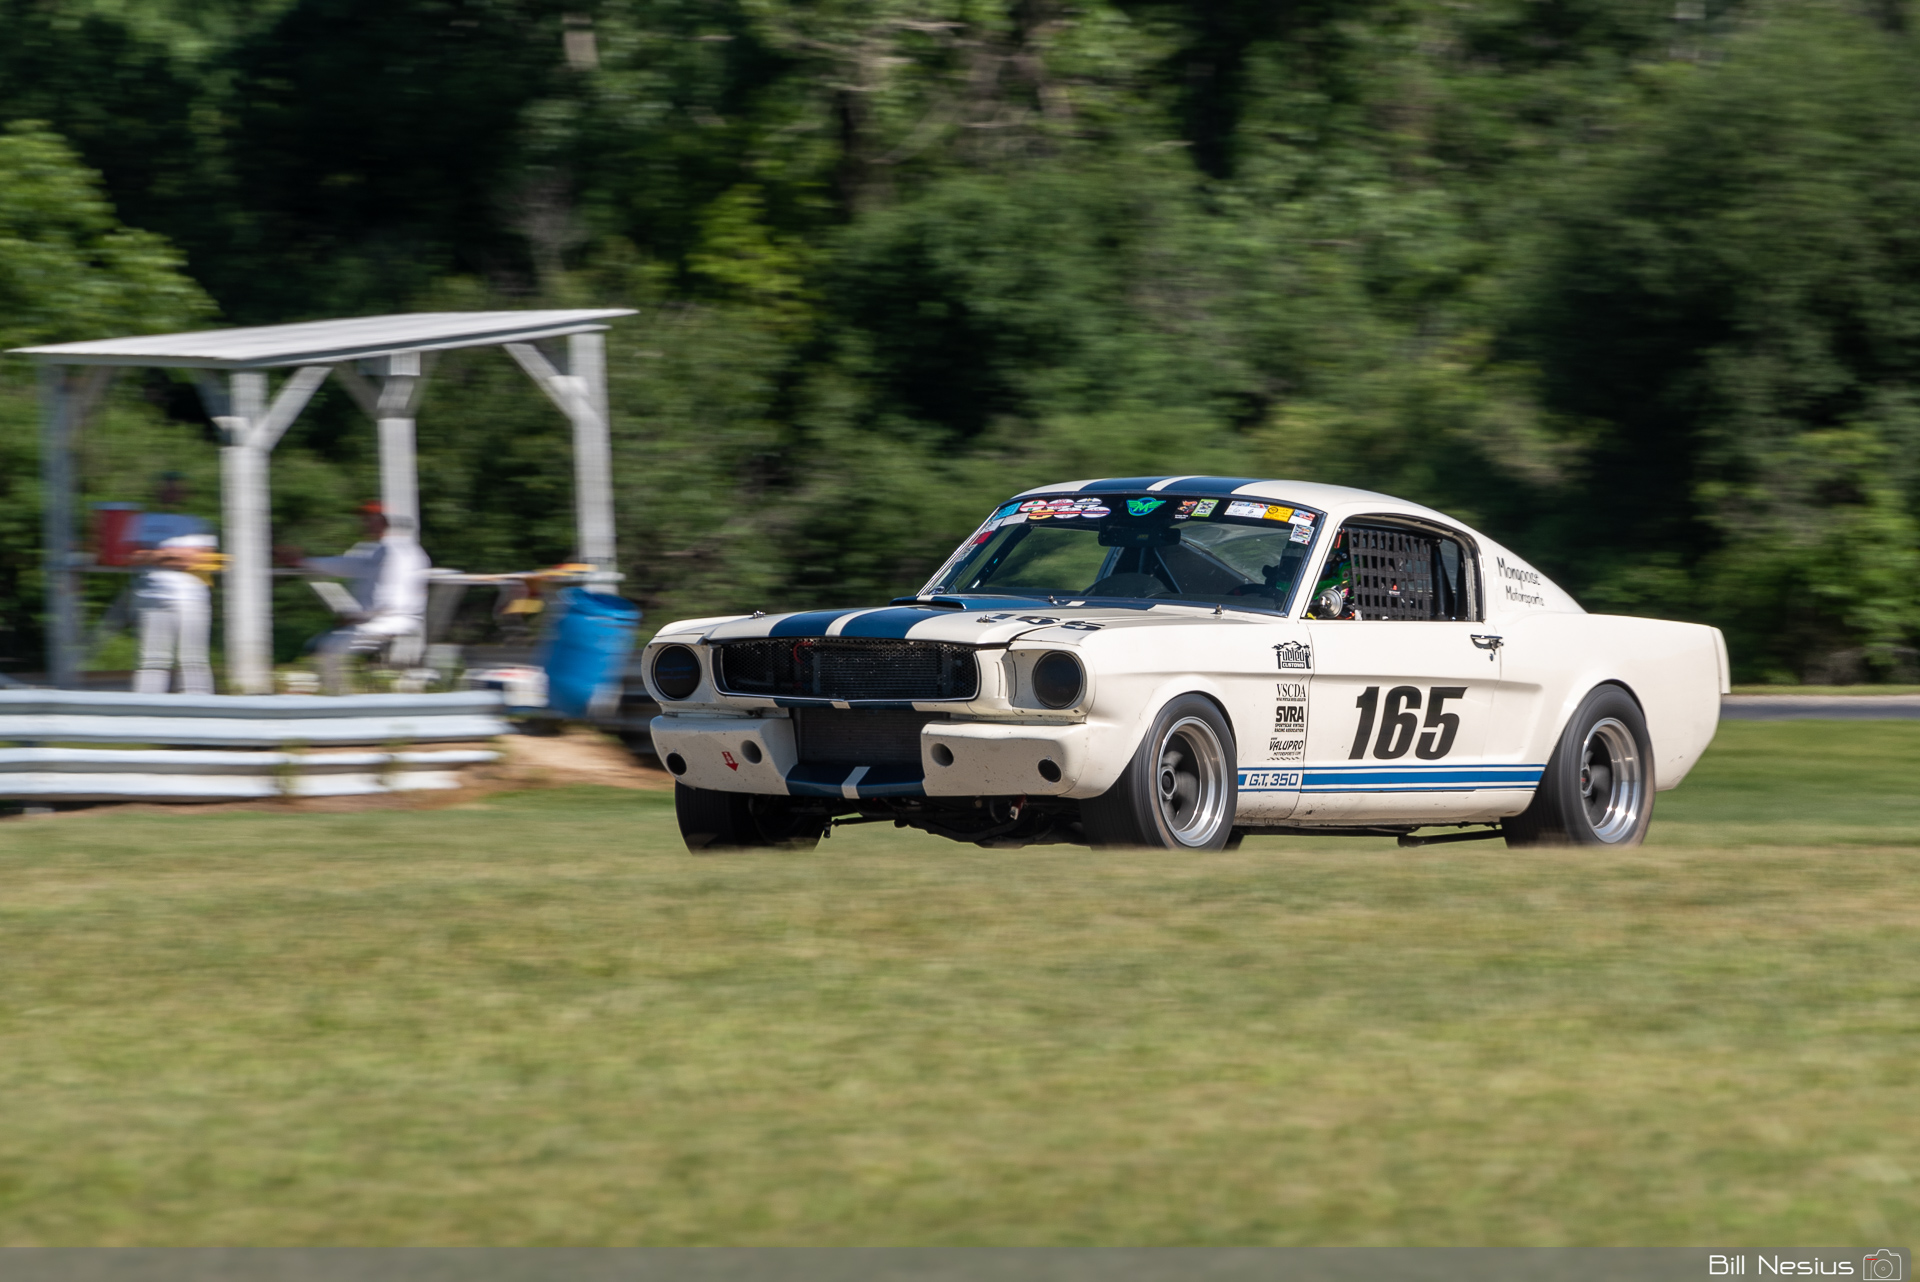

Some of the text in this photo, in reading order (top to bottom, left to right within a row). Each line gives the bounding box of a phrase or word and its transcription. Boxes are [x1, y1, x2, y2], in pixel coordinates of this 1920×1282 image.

[1276, 683, 1306, 698] VSCDA
[1275, 705, 1304, 722] SVRA
[1348, 685, 1469, 760] 165
[1269, 740, 1304, 751] VALUPRO
